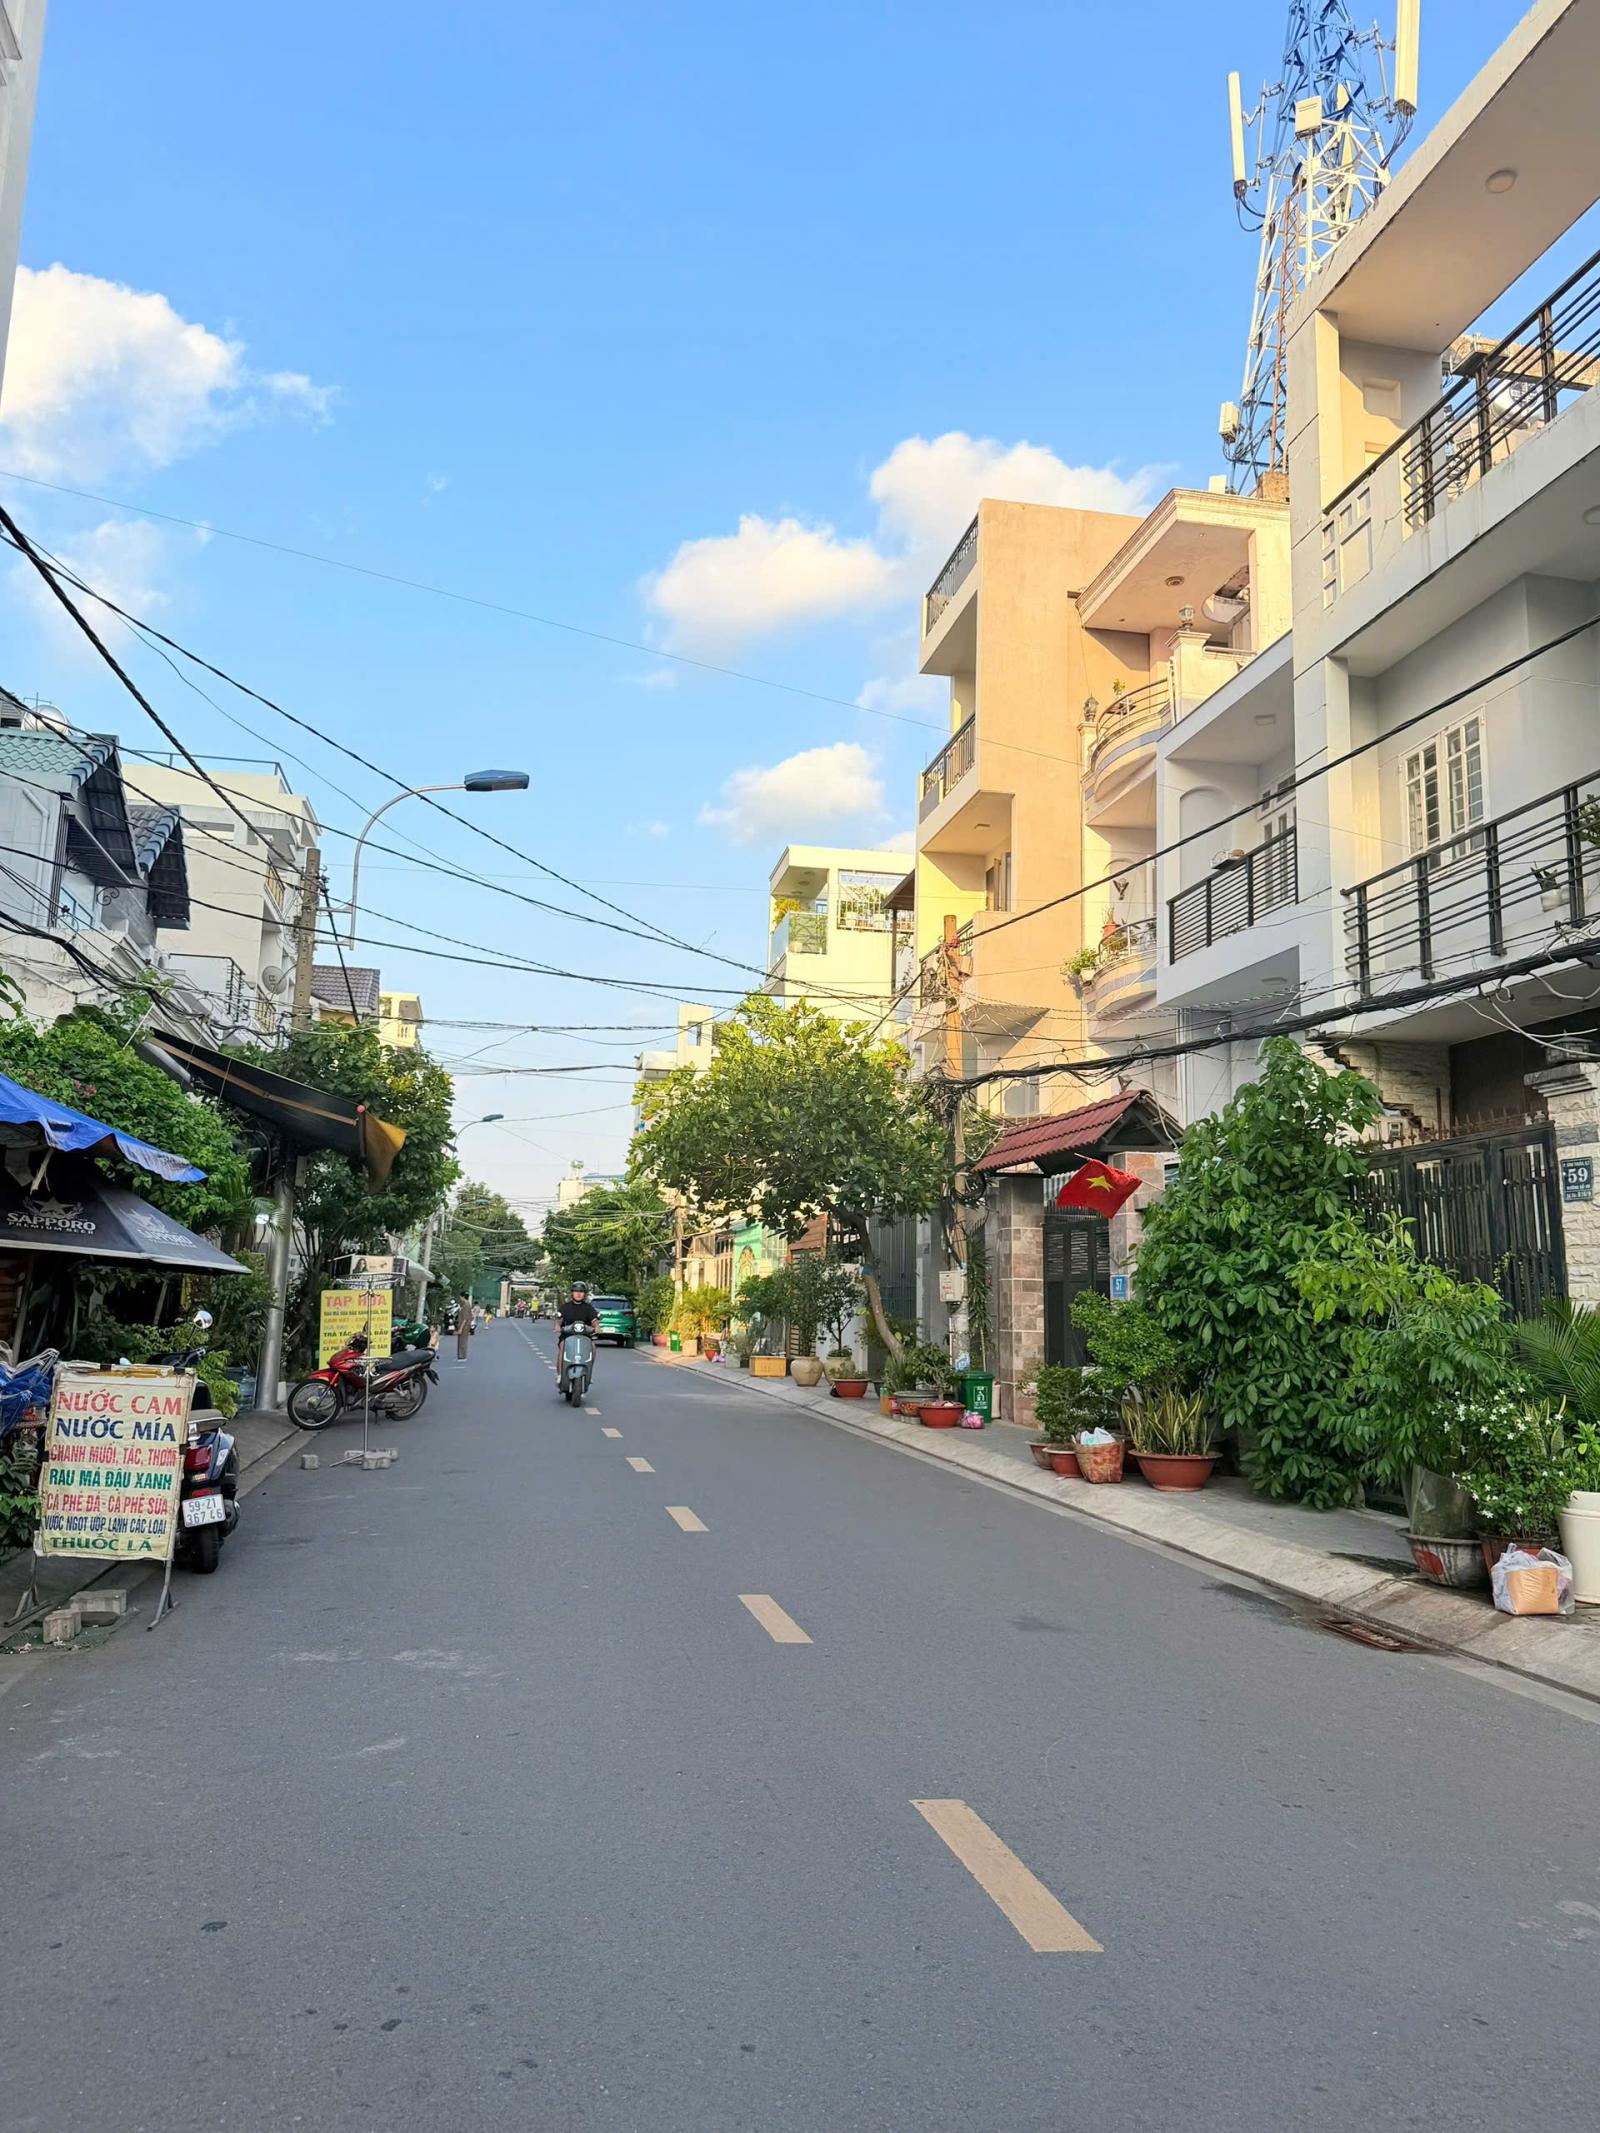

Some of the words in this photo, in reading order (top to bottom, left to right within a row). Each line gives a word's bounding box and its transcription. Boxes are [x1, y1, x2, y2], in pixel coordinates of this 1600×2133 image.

[1568, 1167, 1588, 1184] 59
[7, 1212, 96, 1231] SAPPORO
[1115, 1278, 1123, 1291] 57
[324, 1296, 352, 1309] TẠP
[57, 1389, 123, 1413] NƯỚC
[130, 1395, 182, 1416] CAM
[55, 1414, 124, 1440] NƯỚC
[132, 1416, 177, 1442] MÍA
[50, 1444, 86, 1462] CHANH
[148, 1447, 177, 1467] THƠM
[49, 1468, 75, 1486] RAU
[79, 1466, 101, 1487] MÁ
[105, 1467, 131, 1491] ĐẬU
[134, 1472, 172, 1490] XANH
[188, 1497, 216, 1513] 59-Z1
[66, 1515, 88, 1534] NGỌT
[107, 1517, 128, 1535] LẠNH
[148, 1519, 167, 1537] LOẠI
[50, 1533, 119, 1552] THUỐC
[127, 1536, 152, 1552] LÁ
